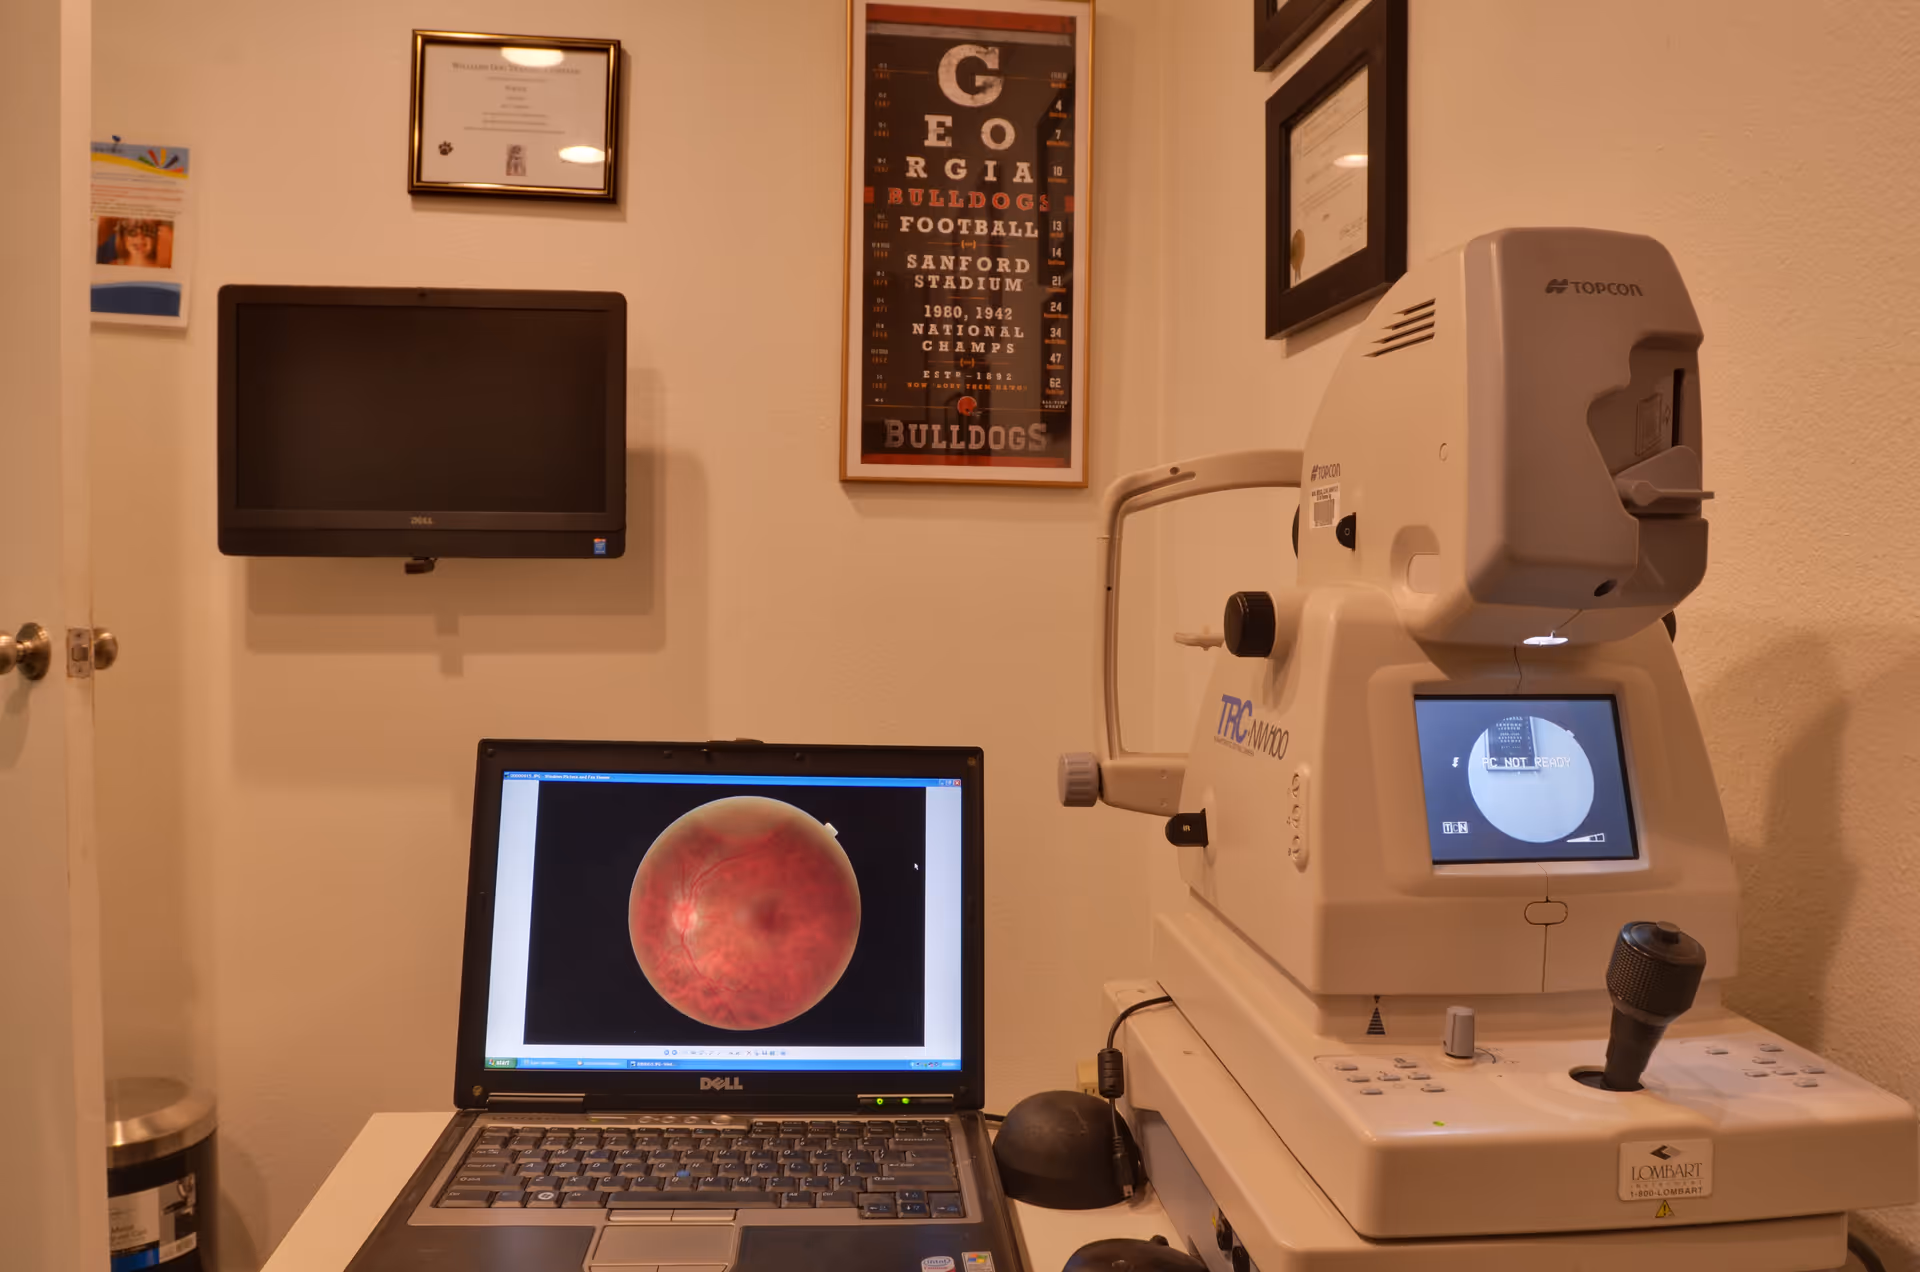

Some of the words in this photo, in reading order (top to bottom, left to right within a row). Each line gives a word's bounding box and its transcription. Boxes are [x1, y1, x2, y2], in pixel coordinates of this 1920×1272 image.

[938, 44, 1004, 107] G
[1055, 100, 1062, 110] 4
[1055, 129, 1061, 140] 7
[1053, 166, 1062, 176] 10
[888, 188, 1049, 212] BULLDOGS
[900, 216, 1038, 238] FOOTBALL
[1052, 220, 1062, 231] 13
[1052, 247, 1062, 258] 14
[906, 254, 1030, 273] SANFORD
[914, 275, 1023, 292] STADIUM
[1052, 276, 1061, 286] 21
[1570, 281, 1643, 296] TOPCON
[976, 306, 1013, 320] 1942
[1051, 302, 1062, 312] 24
[912, 323, 1024, 338] NATIONAL
[1050, 327, 1062, 338] 34
[922, 340, 1014, 354] CHAMPS
[1050, 353, 1062, 363] 47
[1050, 378, 1061, 388] 62
[885, 419, 1047, 450] BULLDOGS
[1318, 463, 1340, 479] TOPCON
[1482, 757, 1498, 768] PC
[1504, 757, 1527, 768] NOT
[1535, 757, 1571, 768] READY
[700, 1076, 743, 1090] DELL
[1632, 1163, 1702, 1180] LOMBART
